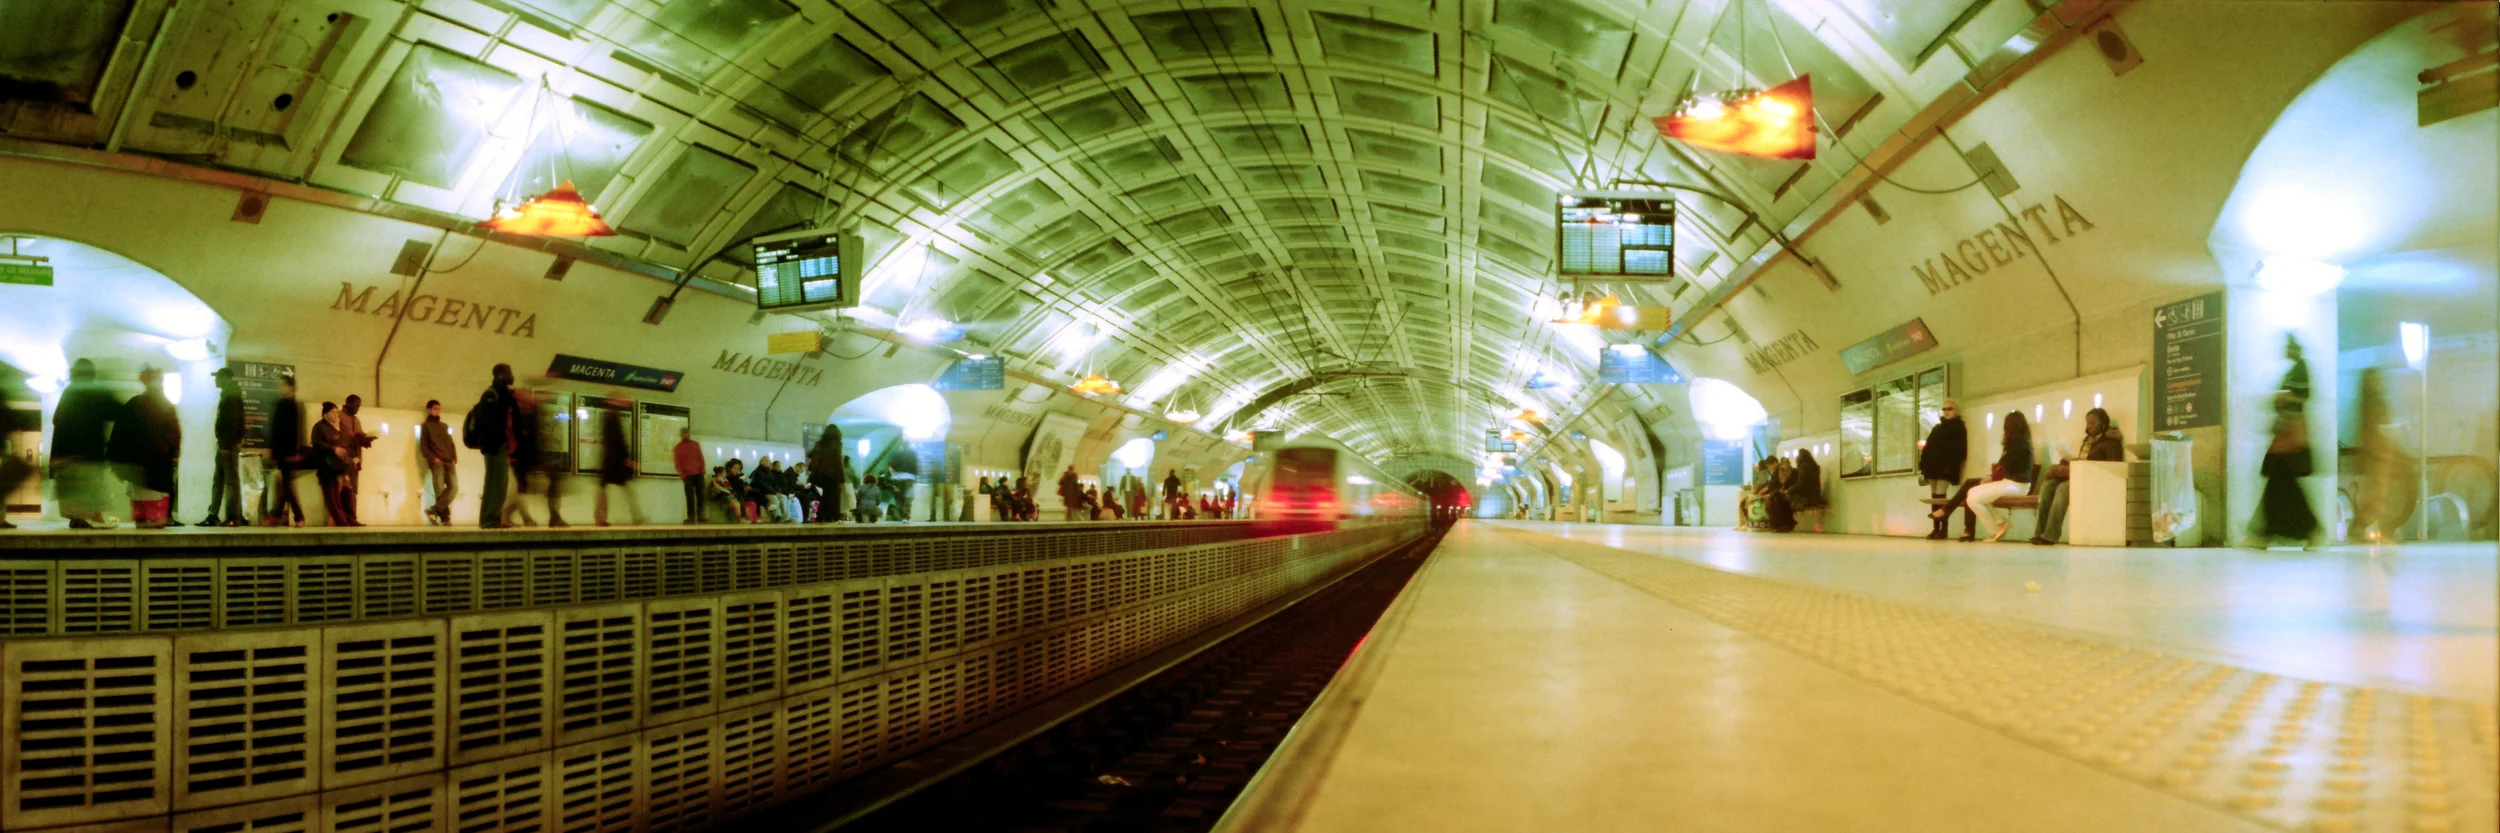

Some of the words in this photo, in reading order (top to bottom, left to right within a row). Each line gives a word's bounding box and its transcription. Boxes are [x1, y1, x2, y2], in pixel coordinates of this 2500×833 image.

[1911, 194, 2095, 297] MAGENTA
[330, 281, 537, 339] MAGENTA
[569, 363, 616, 379] MAGENTA
[711, 349, 824, 387] MAGENTA
[1744, 328, 1820, 374] MAGENTA
